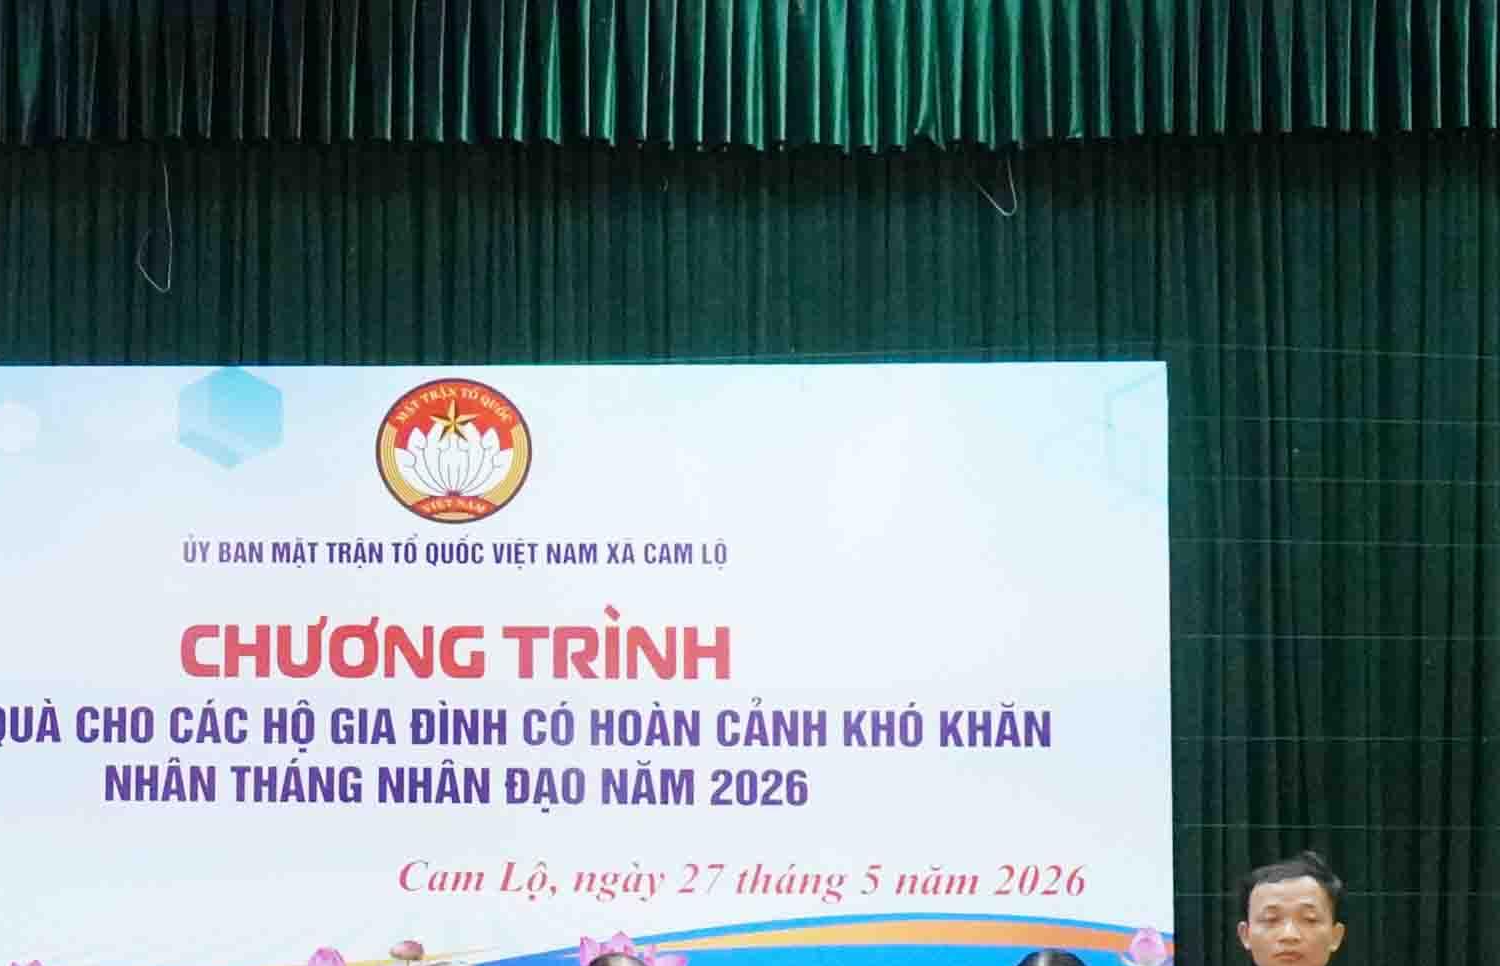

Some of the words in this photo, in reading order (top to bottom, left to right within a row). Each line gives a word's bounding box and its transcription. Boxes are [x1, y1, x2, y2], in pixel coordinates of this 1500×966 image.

[182, 533, 211, 564] ỦY
[219, 541, 264, 564] BAN
[271, 537, 319, 569] MẶT
[325, 537, 384, 569] TRẬN
[391, 533, 418, 565] TỔ
[425, 533, 485, 567] QUỐC
[492, 538, 539, 570] VIỆT
[546, 543, 598, 565] NAM
[606, 537, 636, 565] XÃ
[644, 543, 694, 565] CAM
[701, 538, 728, 571] LỘ
[180, 616, 485, 679] CHƯƠNG
[502, 605, 730, 680] TRÌNH
[75, 706, 154, 744] CHO
[169, 699, 248, 744] CÁC
[263, 699, 315, 753] HỘ
[330, 708, 397, 745] GIA
[410, 700, 507, 746] ĐÌNH
[522, 701, 575, 746] CÓ
[590, 701, 701, 747] HOÀN
[716, 697, 827, 747] CẢNH
[843, 702, 924, 747] KHÓ
[939, 702, 1052, 748] KHĂN
[104, 757, 216, 802] NHÂN
[231, 757, 362, 803] THÁNG
[378, 759, 490, 804] NHÂN
[504, 768, 585, 812] ĐẠO
[601, 760, 695, 805] NĂM
[710, 769, 808, 806] 2026
[398, 860, 485, 892] Cam
[500, 861, 558, 901] Lộ,
[573, 862, 665, 902] ngày
[677, 864, 725, 893] 27
[735, 863, 845, 902] tháng
[861, 865, 882, 894] 5
[895, 866, 979, 896] năm
[995, 865, 1086, 896] 2026
